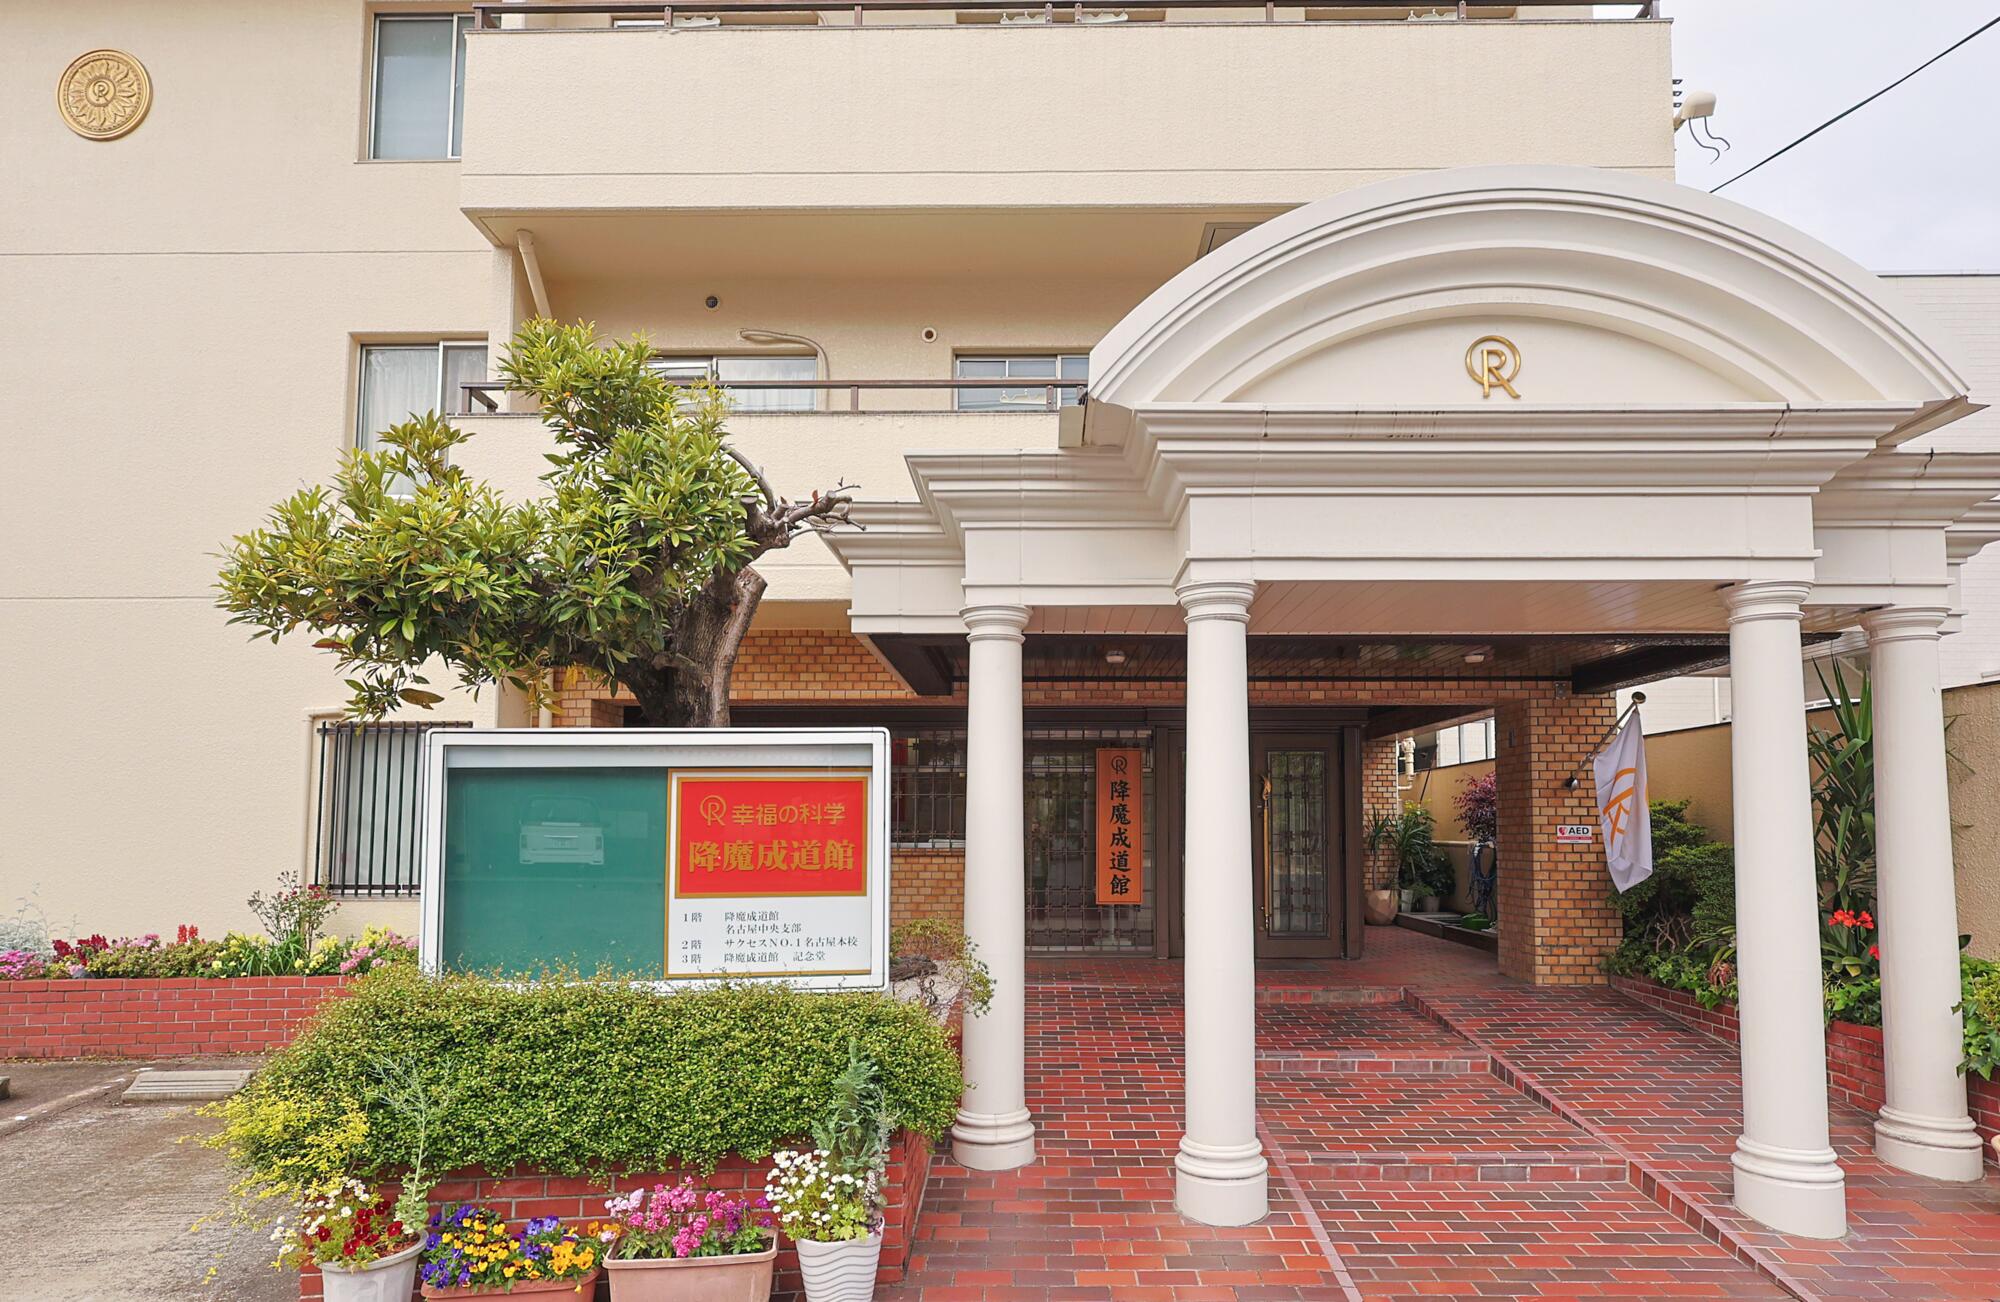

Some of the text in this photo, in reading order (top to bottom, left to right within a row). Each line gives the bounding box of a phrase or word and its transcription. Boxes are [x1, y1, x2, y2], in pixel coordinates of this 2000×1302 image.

[731, 803, 846, 826] 幸福の科学
[1568, 827, 1589, 835] AED
[1109, 780, 1131, 896] 降魔成道館
[688, 840, 855, 873] 降魔成道館
[683, 911, 780, 923] 1階 降魔成道館
[726, 923, 802, 935] 名古屋中央支部
[681, 939, 702, 951] 2階
[681, 951, 826, 964] 3階 降魔成道館 記念堂
